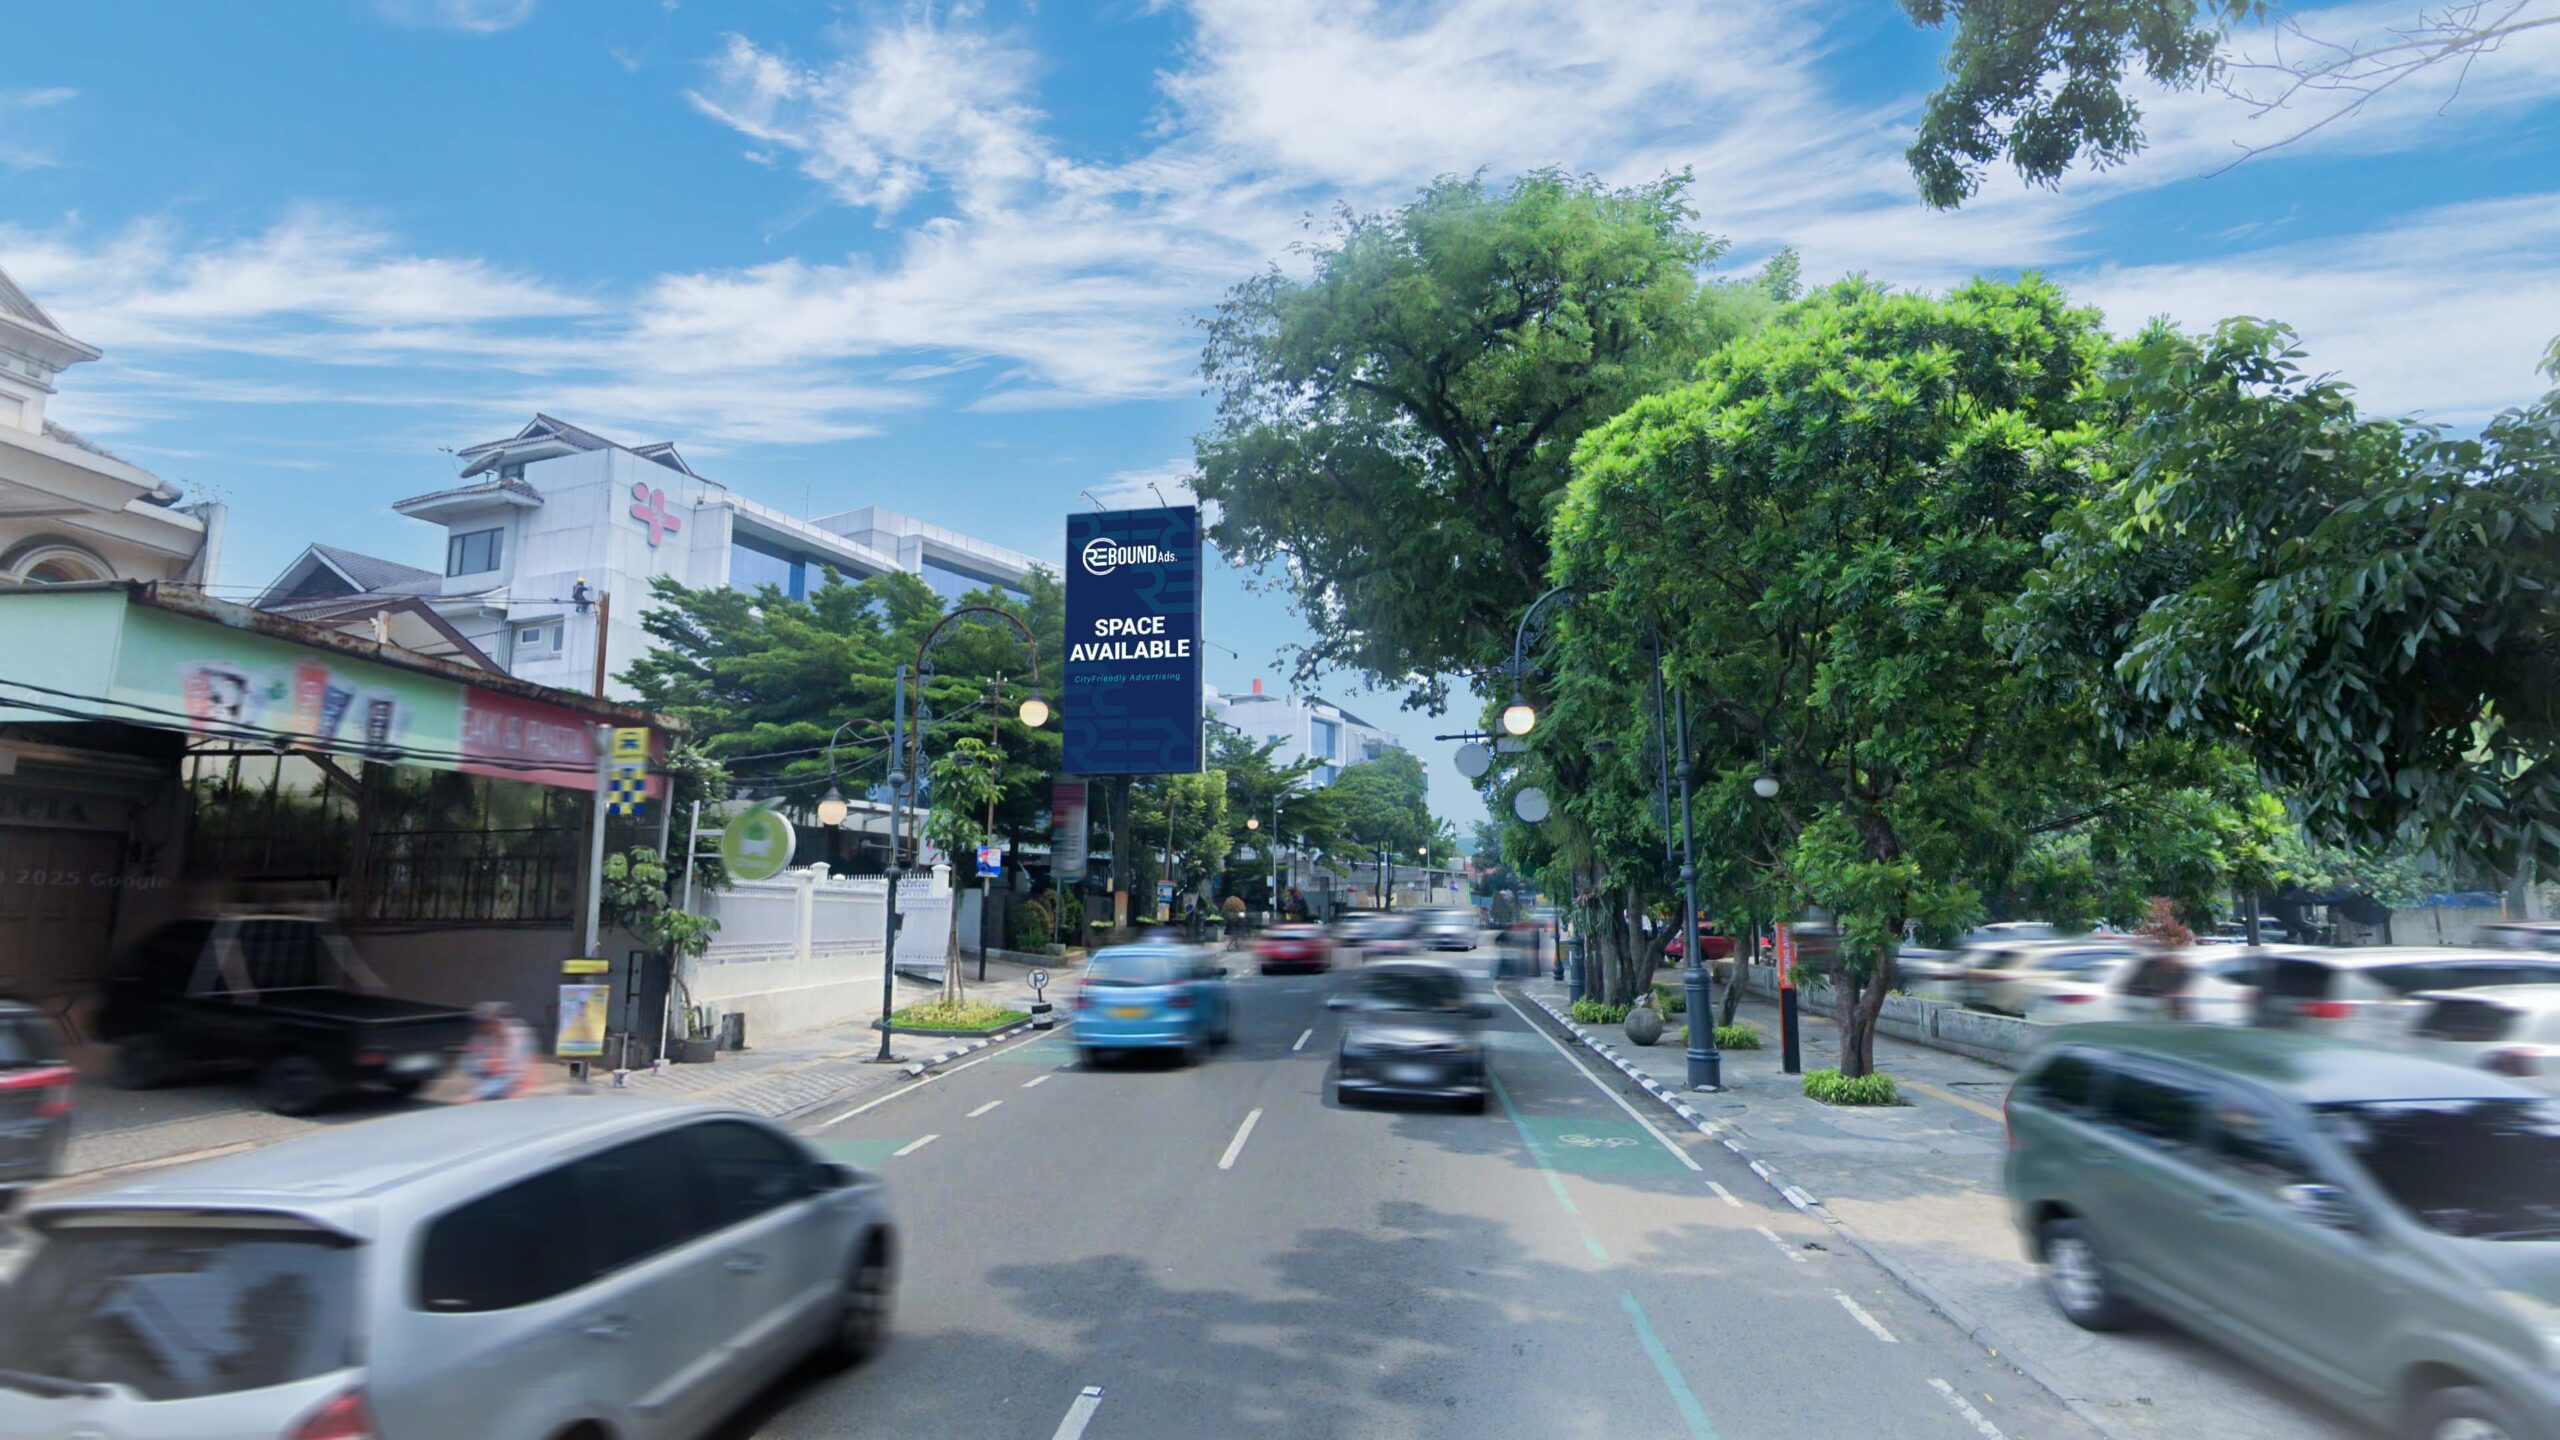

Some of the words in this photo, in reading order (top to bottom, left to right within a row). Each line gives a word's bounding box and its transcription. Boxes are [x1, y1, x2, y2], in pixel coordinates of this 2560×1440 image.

[1157, 550, 1178, 563] Ads.
[1094, 616, 1165, 637] SPACE
[1070, 639, 1190, 661] AVAILABLE
[1074, 674, 1127, 685] CityFriendly
[1129, 672, 1181, 682] Advertising
